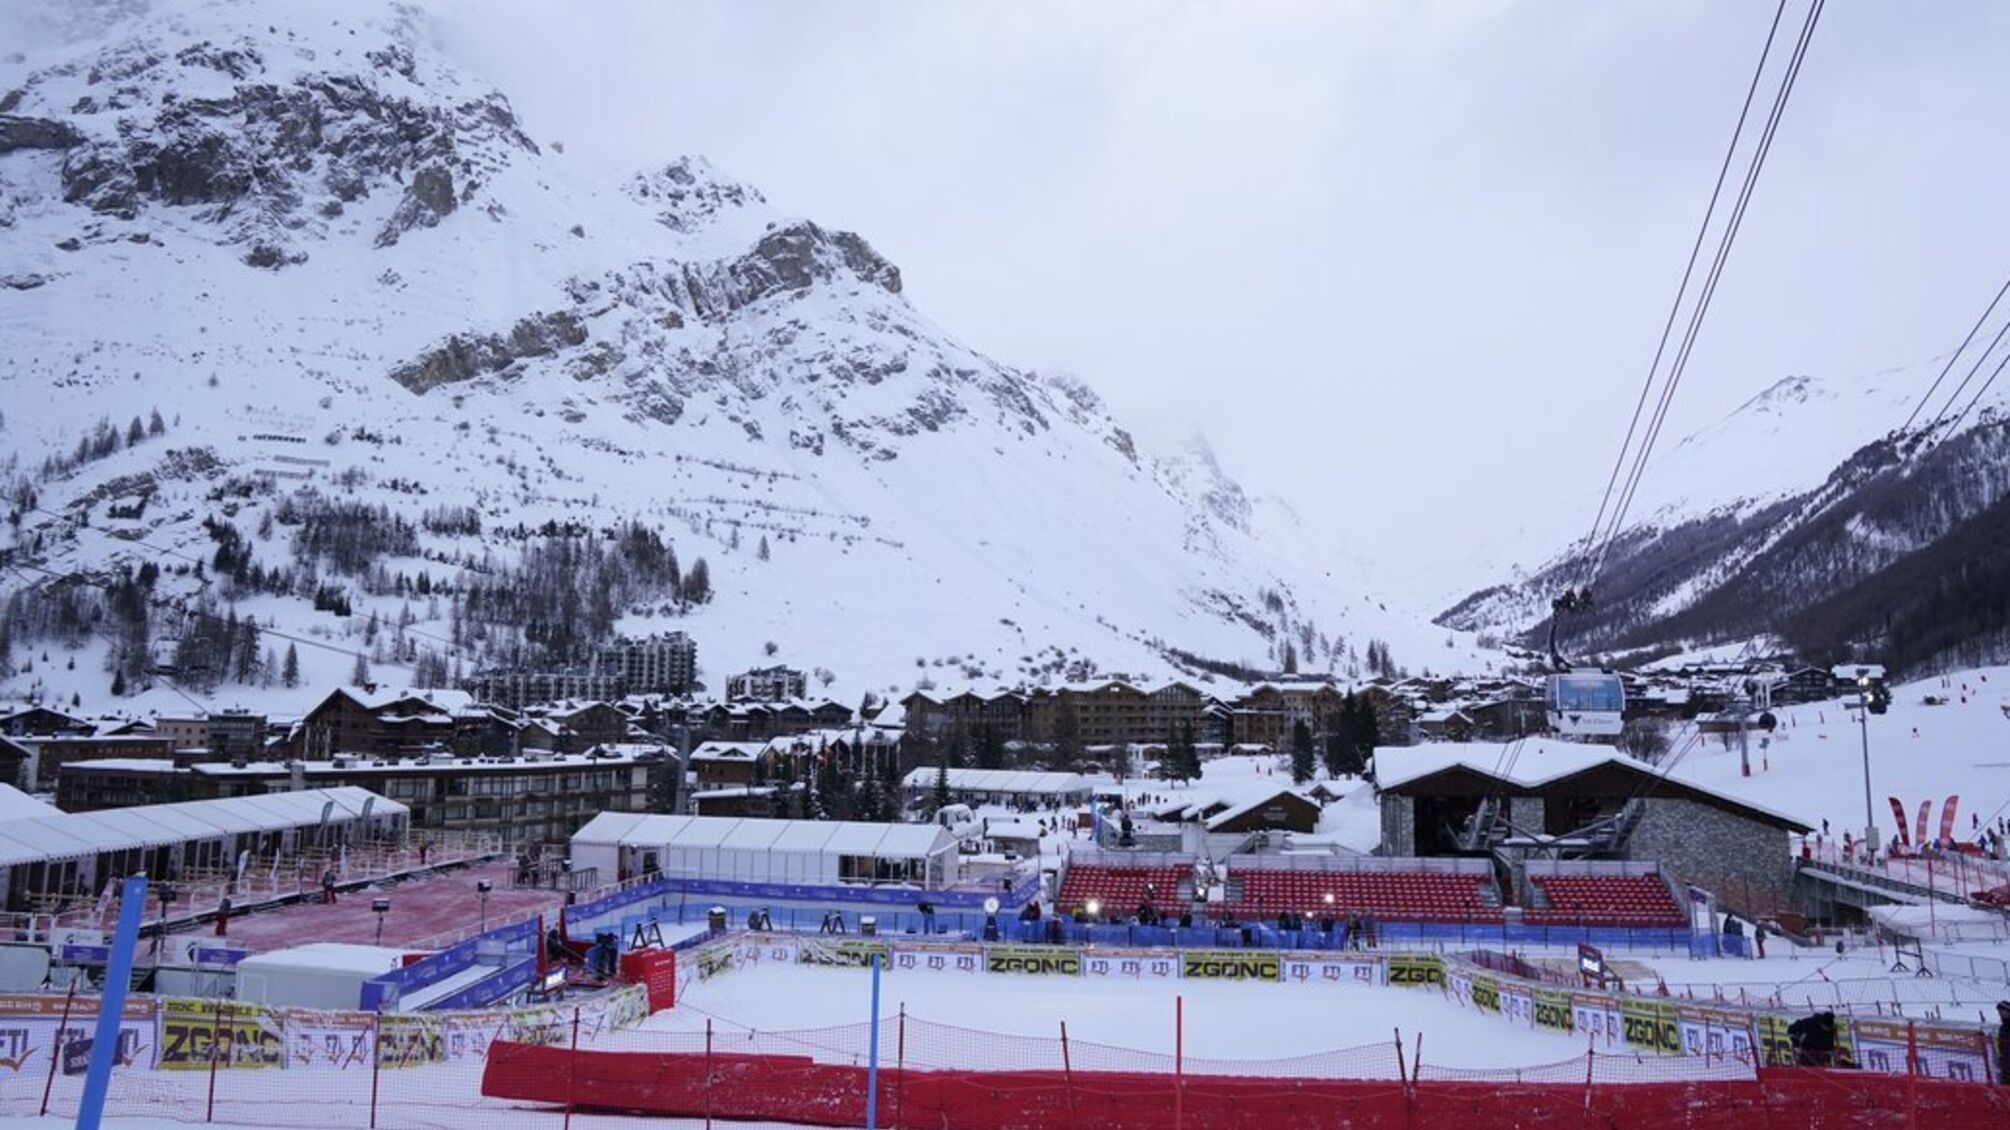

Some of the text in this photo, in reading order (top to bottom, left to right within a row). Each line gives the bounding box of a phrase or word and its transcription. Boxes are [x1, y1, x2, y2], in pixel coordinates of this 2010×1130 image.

[989, 957, 1079, 975] ZGONC
[1186, 961, 1278, 979] ZGONC
[1389, 967, 1442, 983] ZGO
[1624, 1015, 1679, 1051] ZGONC
[162, 1025, 280, 1062] ZGONC
